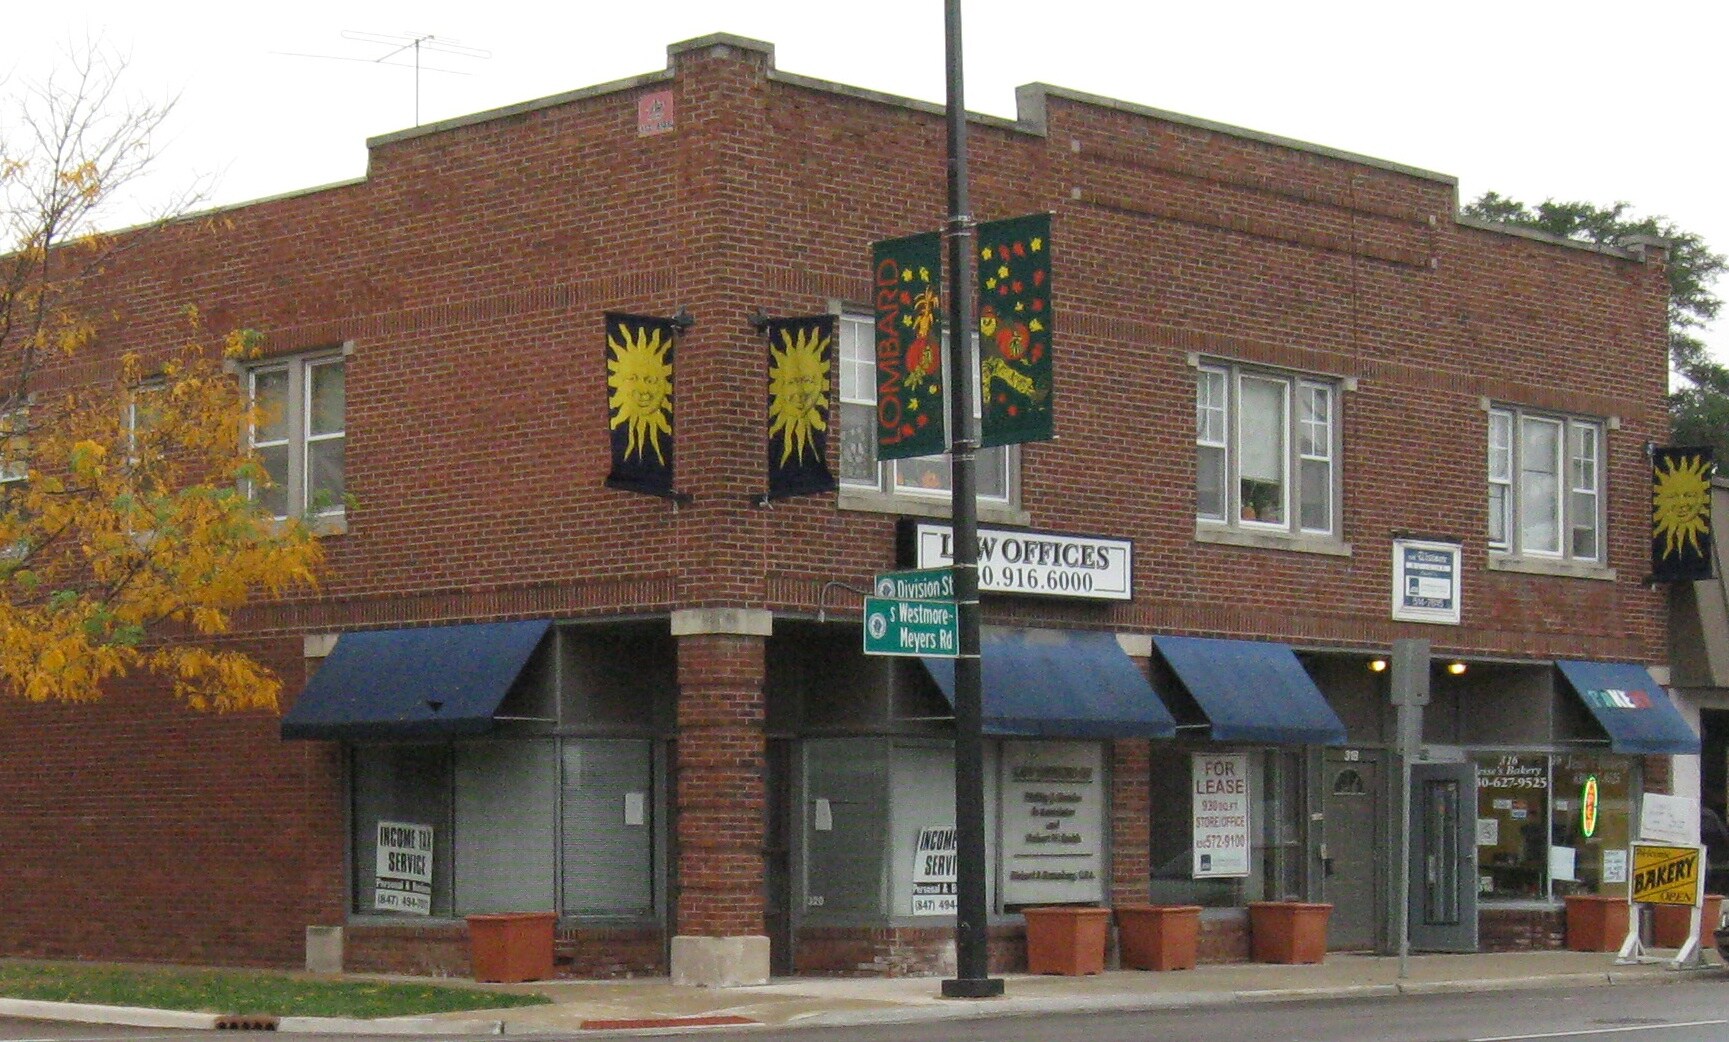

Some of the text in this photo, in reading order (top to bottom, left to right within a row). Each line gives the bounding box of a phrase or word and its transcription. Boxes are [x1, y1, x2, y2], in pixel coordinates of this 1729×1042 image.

[877, 257, 902, 445] LOMBARD
[940, 533, 1110, 570] LW OFFICES
[897, 575, 954, 599] Division St
[977, 564, 1093, 592] 0.916.6000
[900, 626, 953, 653] Meyers Rd
[1205, 761, 1235, 776] FOR
[1507, 766, 1542, 777] Bakery
[1196, 779, 1245, 794] LEASE
[380, 826, 415, 849] INCOME
[920, 830, 957, 851] INCOME
[388, 852, 425, 875] SERVICE
[924, 855, 957, 876] SERVI
[1634, 854, 1696, 895] BAKERY
[1660, 890, 1691, 902] OPEN
